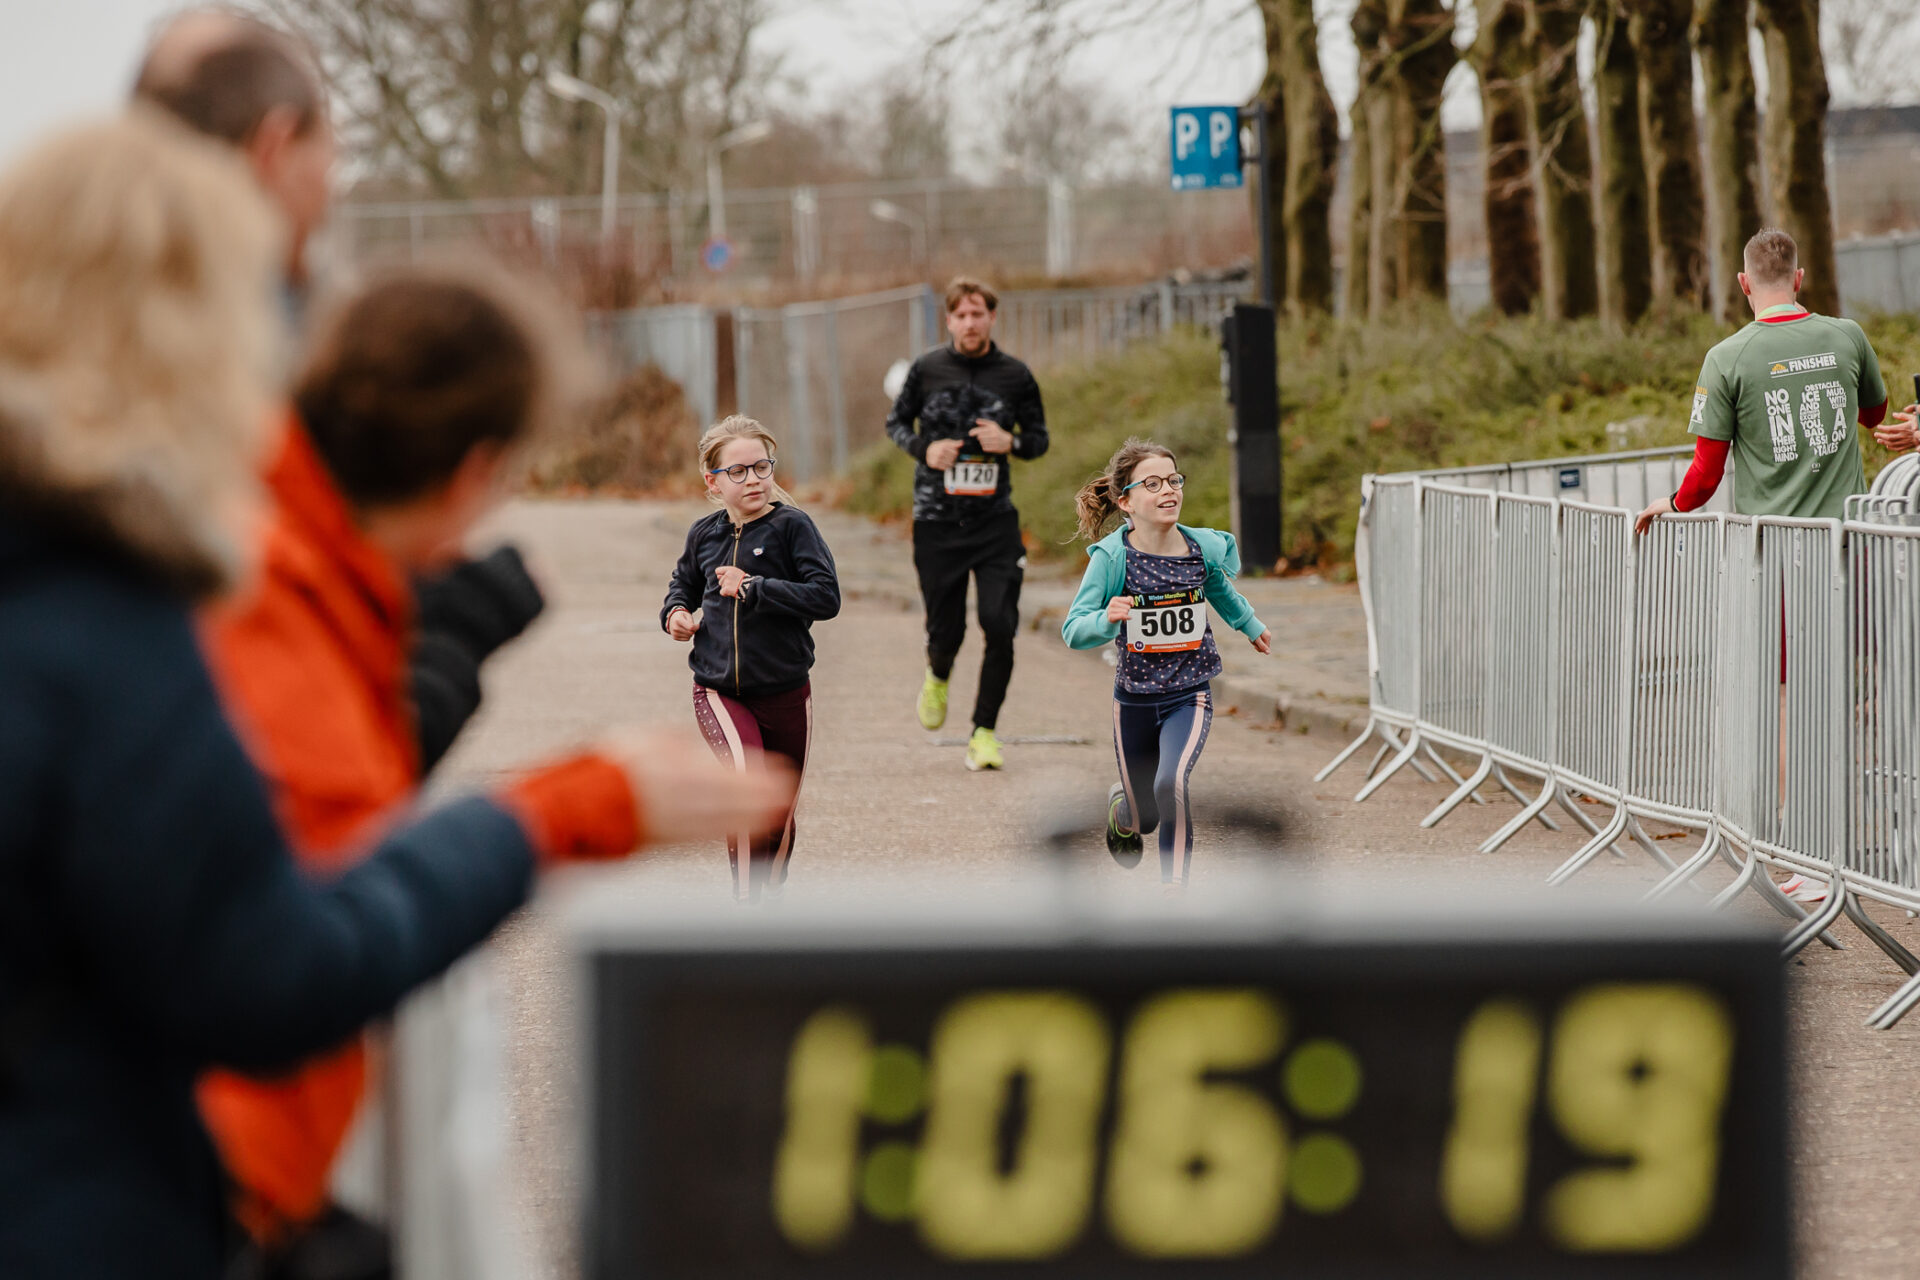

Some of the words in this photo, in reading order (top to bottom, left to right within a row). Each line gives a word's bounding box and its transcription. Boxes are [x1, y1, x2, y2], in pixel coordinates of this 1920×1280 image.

[1175, 112, 1200, 161] P
[1209, 111, 1233, 159] P
[1788, 355, 1837, 372] FINISHER
[1804, 380, 1842, 392] OBSTACLES,
[1826, 387, 1846, 398] MUD,
[1764, 388, 1790, 407] NO
[1801, 390, 1821, 404] ICE
[1828, 395, 1847, 405] WITH
[1767, 403, 1792, 416] ONE
[1800, 401, 1820, 411] AND
[1768, 413, 1795, 438] IN
[1800, 418, 1824, 430] YOU.
[1834, 407, 1847, 431] A
[1804, 427, 1825, 438] BAD
[1831, 428, 1847, 442] ON
[1772, 434, 1797, 447] THEIR
[1773, 444, 1797, 454] RIGHT
[1817, 441, 1839, 456] TAKES
[1774, 452, 1795, 463] MIND
[950, 466, 994, 485] 1120
[1141, 607, 1195, 637] 508
